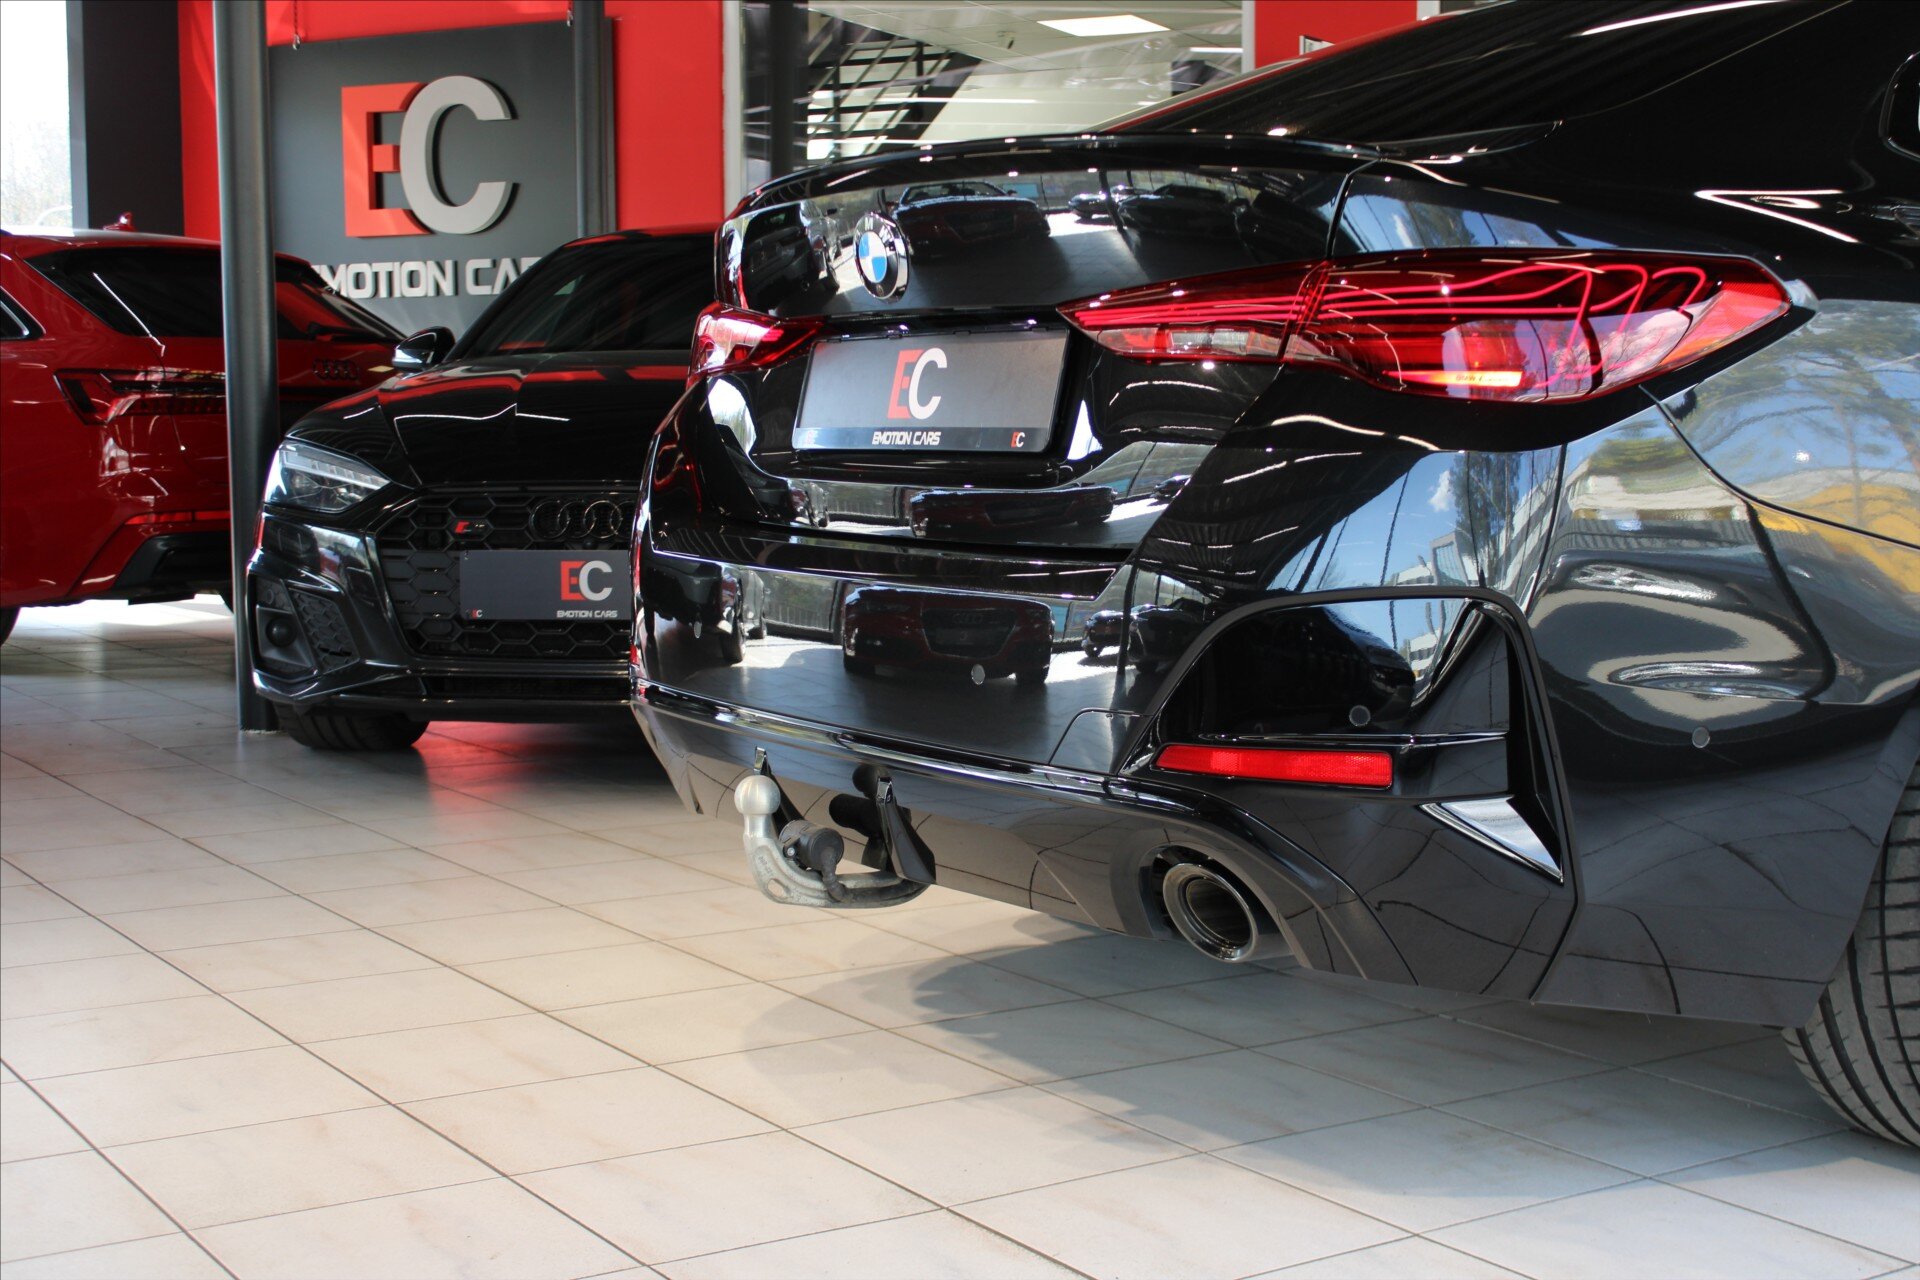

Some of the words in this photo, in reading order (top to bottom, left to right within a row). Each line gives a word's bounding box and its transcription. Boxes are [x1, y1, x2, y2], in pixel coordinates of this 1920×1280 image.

[341, 75, 514, 236] EC
[311, 259, 457, 299] MOTION
[465, 256, 543, 296] CA
[887, 347, 948, 420] EC
[871, 431, 912, 446] EMOTION
[912, 431, 941, 446] CARS
[1010, 431, 1026, 448] EC
[560, 560, 613, 602] EC
[556, 609, 593, 618] EMOTION
[594, 609, 618, 618] CARS
